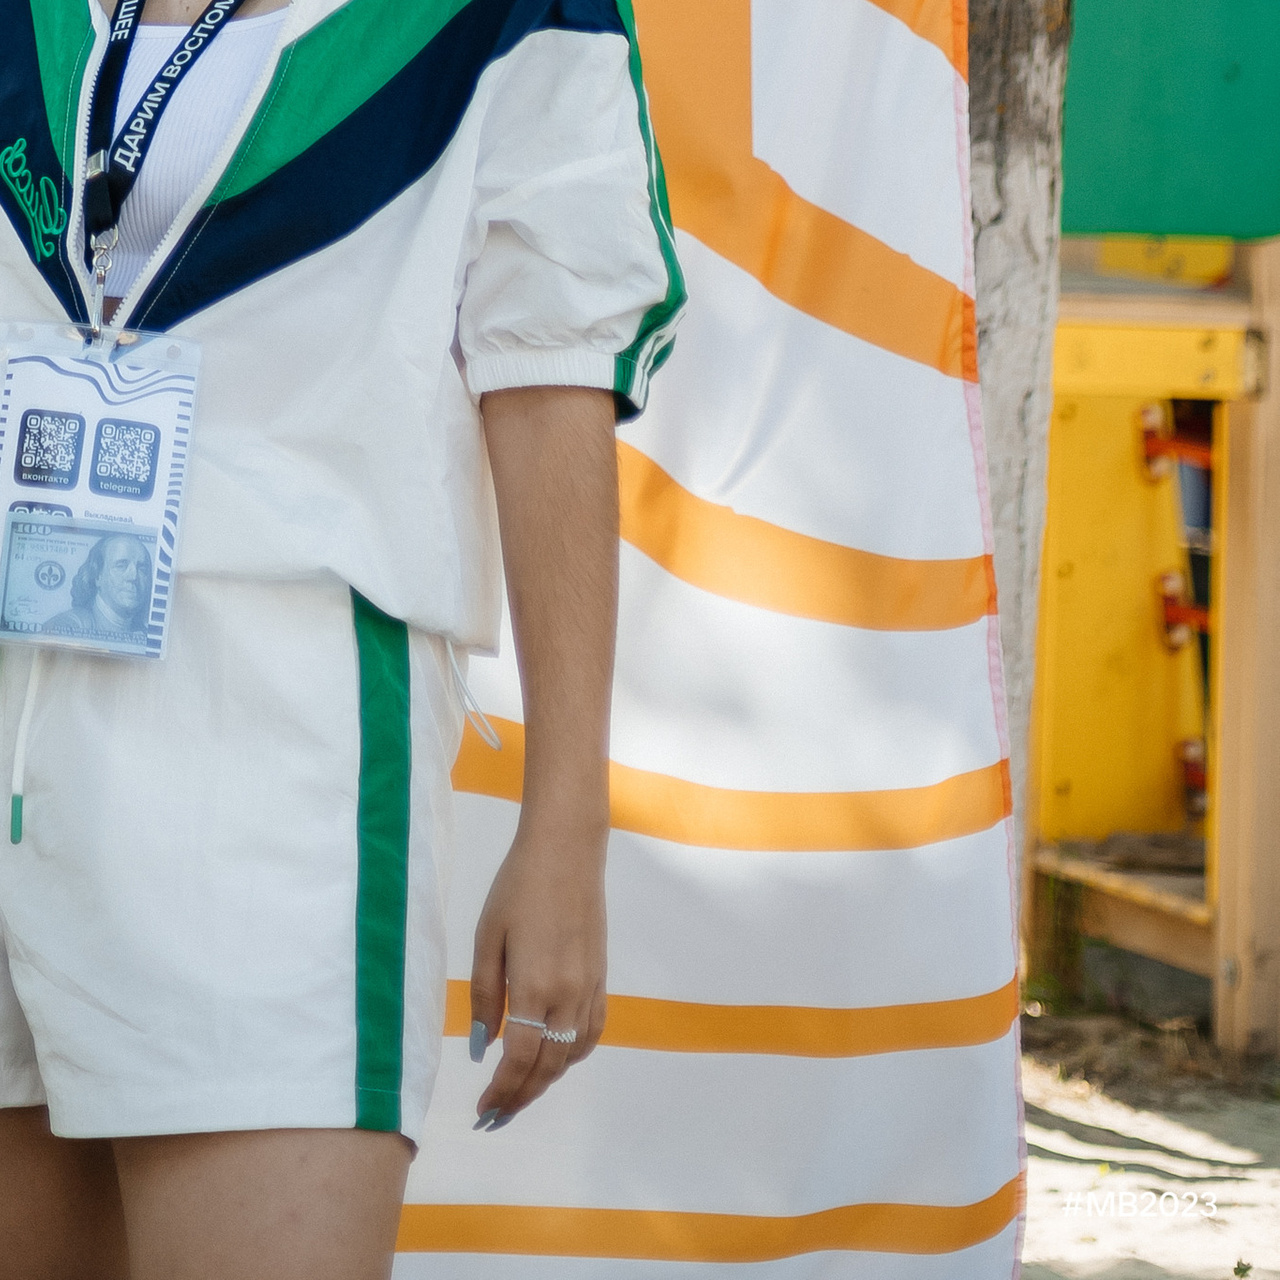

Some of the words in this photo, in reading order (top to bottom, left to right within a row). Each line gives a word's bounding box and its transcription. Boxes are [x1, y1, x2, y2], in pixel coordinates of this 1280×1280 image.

[113, 80, 172, 173] ДАРИМ
[21, 472, 70, 485] вконтакте
[99, 481, 141, 495] telegram
[14, 523, 53, 536] 100
